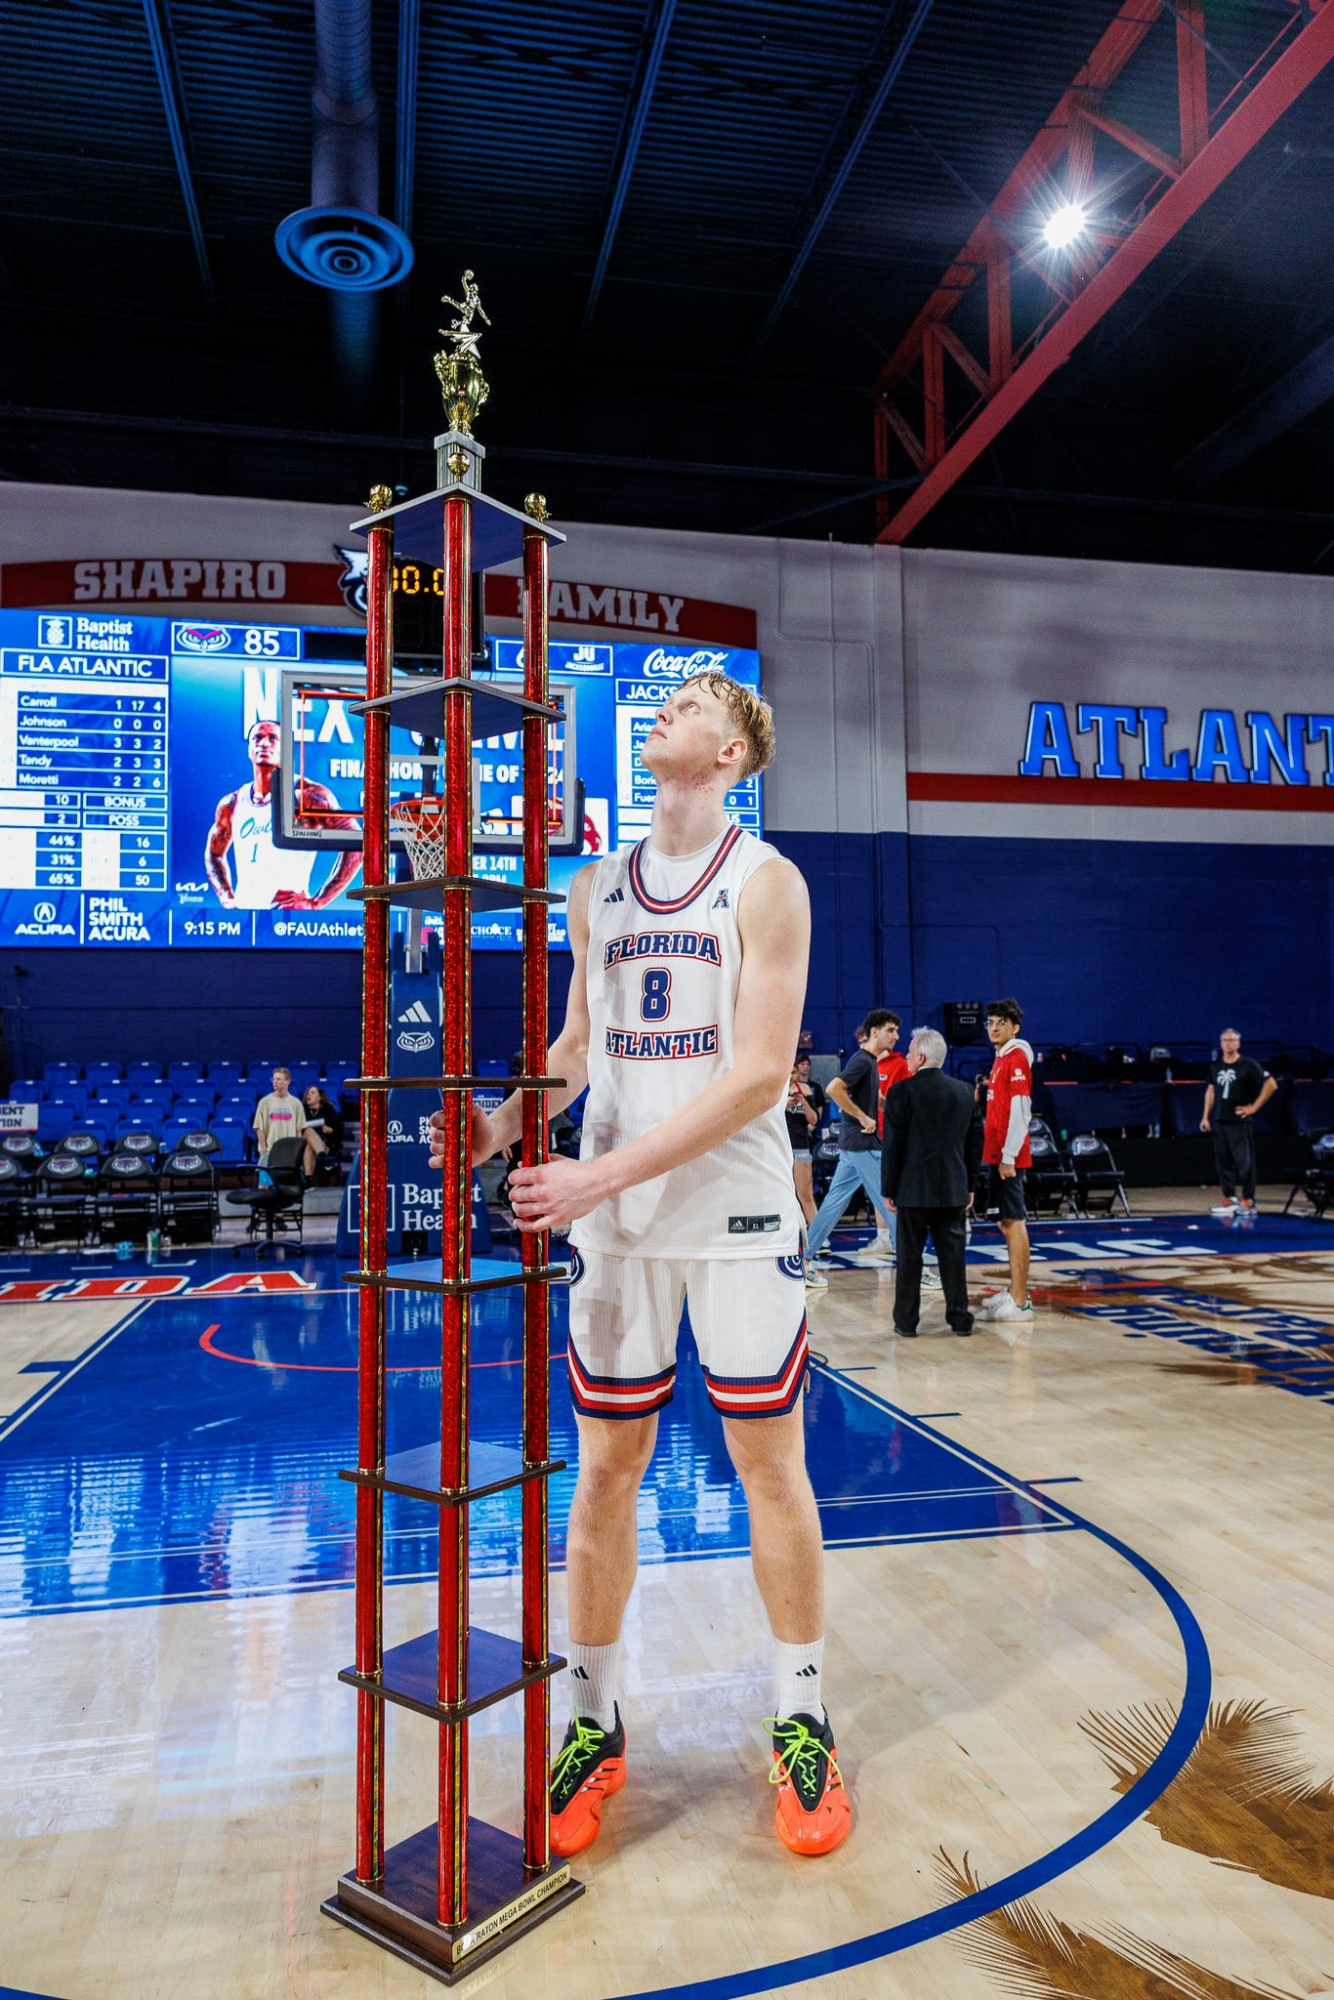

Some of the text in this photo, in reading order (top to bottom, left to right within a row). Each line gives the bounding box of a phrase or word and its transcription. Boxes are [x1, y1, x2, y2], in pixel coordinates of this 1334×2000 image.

[74, 560, 286, 600] SHAPIRO
[76, 617, 134, 636] Baptist
[76, 634, 130, 652] Health
[243, 629, 280, 656] 85
[573, 646, 596, 662] JU
[18, 654, 153, 678] FLA ATLANTIC
[643, 648, 729, 679] Coca-Cola
[20, 695, 162, 711] Carroll 1 17 4
[243, 666, 355, 744] NEX
[19, 715, 162, 730] Johnson 0 0 0
[19, 734, 161, 750] Vanterpool 3 3 2
[18, 753, 161, 769] Tandy 2 3 3
[18, 773, 161, 788] Moretti 2 2 6
[496, 764, 519, 783] OF
[746, 779, 753, 789] 2
[55, 793, 70, 805] 10
[104, 796, 147, 808] BONUS
[729, 795, 754, 806] 0 1
[57, 813, 66, 825] 2
[108, 814, 140, 826] POSS
[240, 816, 272, 840] Owl
[48, 834, 76, 847] 44%
[136, 837, 150, 848] 16
[50, 854, 75, 866] 31%
[250, 842, 258, 863] 1
[138, 856, 147, 867] 6
[489, 856, 517, 871] 14TH
[48, 873, 75, 885] 65%
[135, 874, 150, 886] 50
[89, 897, 128, 912] PHIL
[88, 912, 143, 927] SMITH
[14, 923, 76, 936] ACURA
[88, 926, 151, 941] ACURA
[184, 921, 241, 936] 9:15 PM
[273, 922, 364, 937] @FAUAthlet
[604, 931, 721, 970] FLORIDA
[641, 967, 671, 1022] 8
[606, 1024, 719, 1061] ATLANTIC
[475, 1919, 499, 1942] RATON
[498, 1907, 518, 1926] MEGA
[518, 1896, 537, 1911] BOWL
[536, 1871, 568, 1899] CHAMPION
